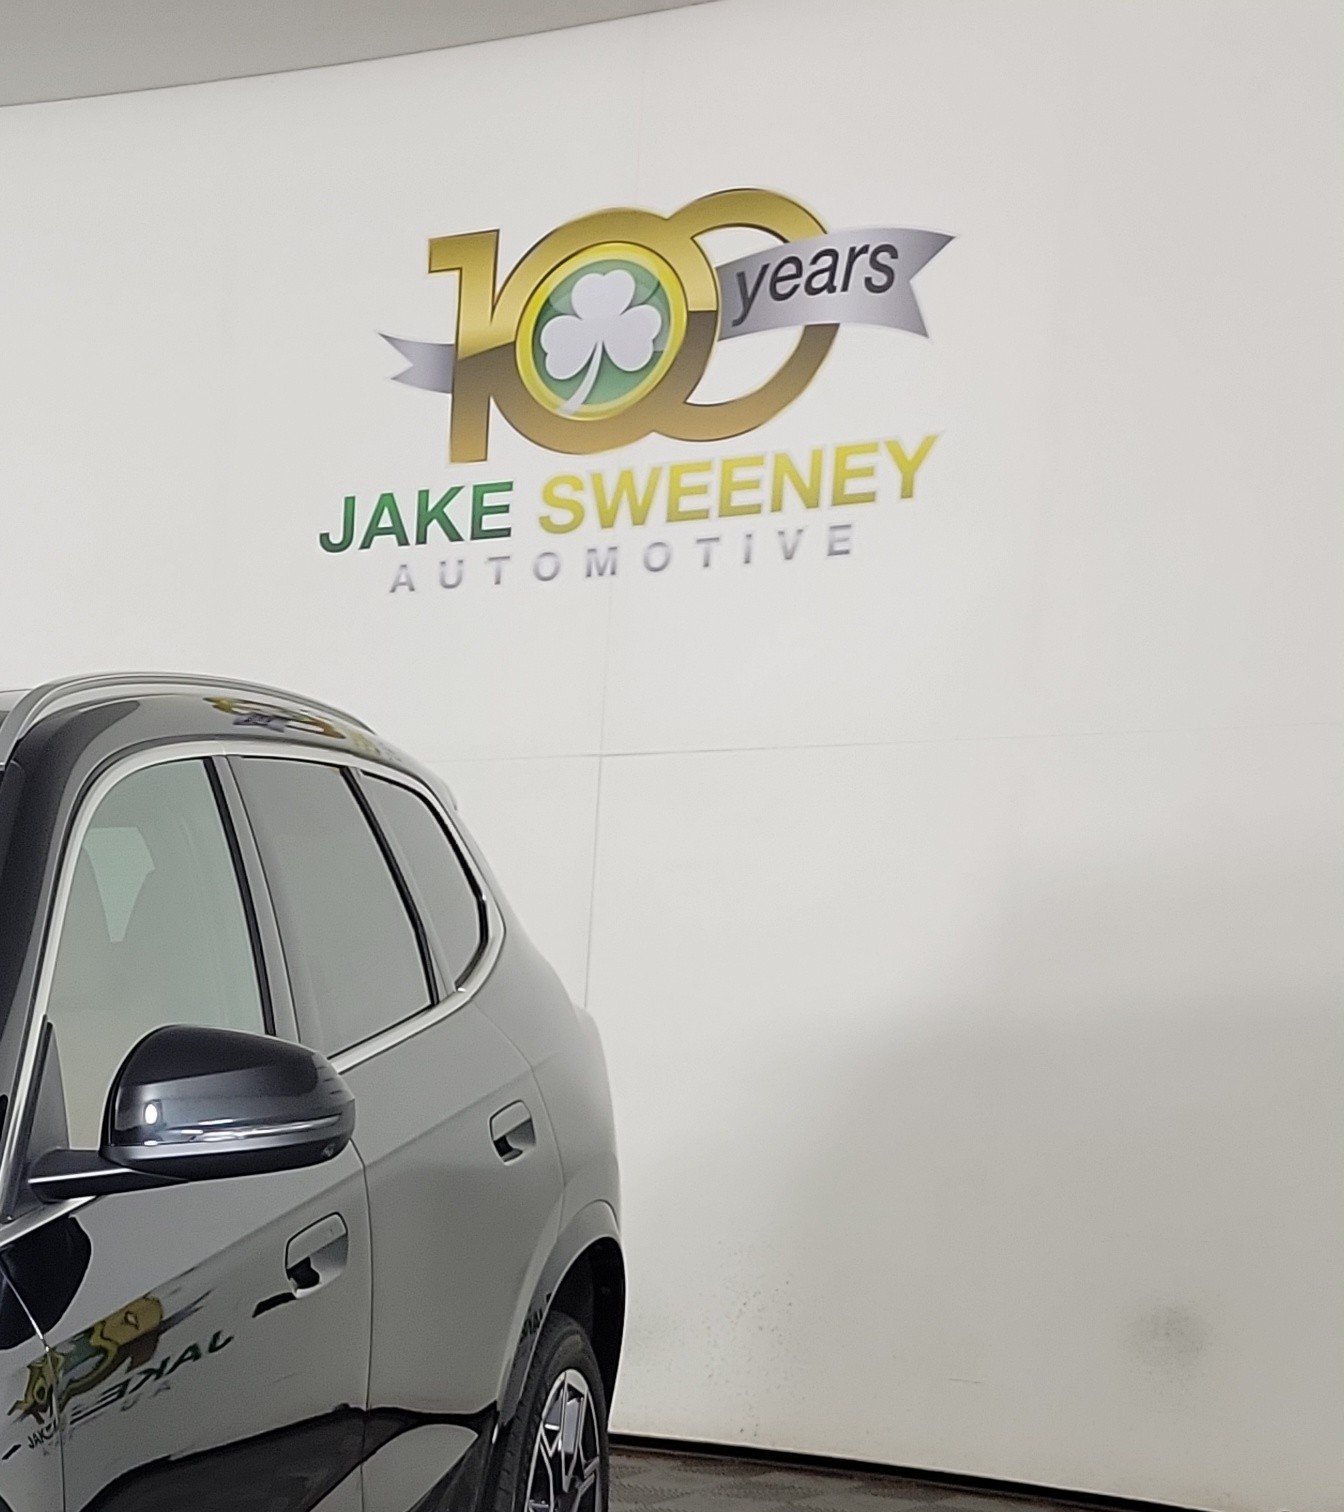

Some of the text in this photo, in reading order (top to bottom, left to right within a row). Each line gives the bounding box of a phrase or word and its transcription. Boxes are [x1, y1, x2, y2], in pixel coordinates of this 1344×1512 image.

[427, 187, 900, 464] 100 years
[317, 433, 942, 555] JAKE SWEENEY
[388, 522, 855, 595] AUTOMOTIVE
